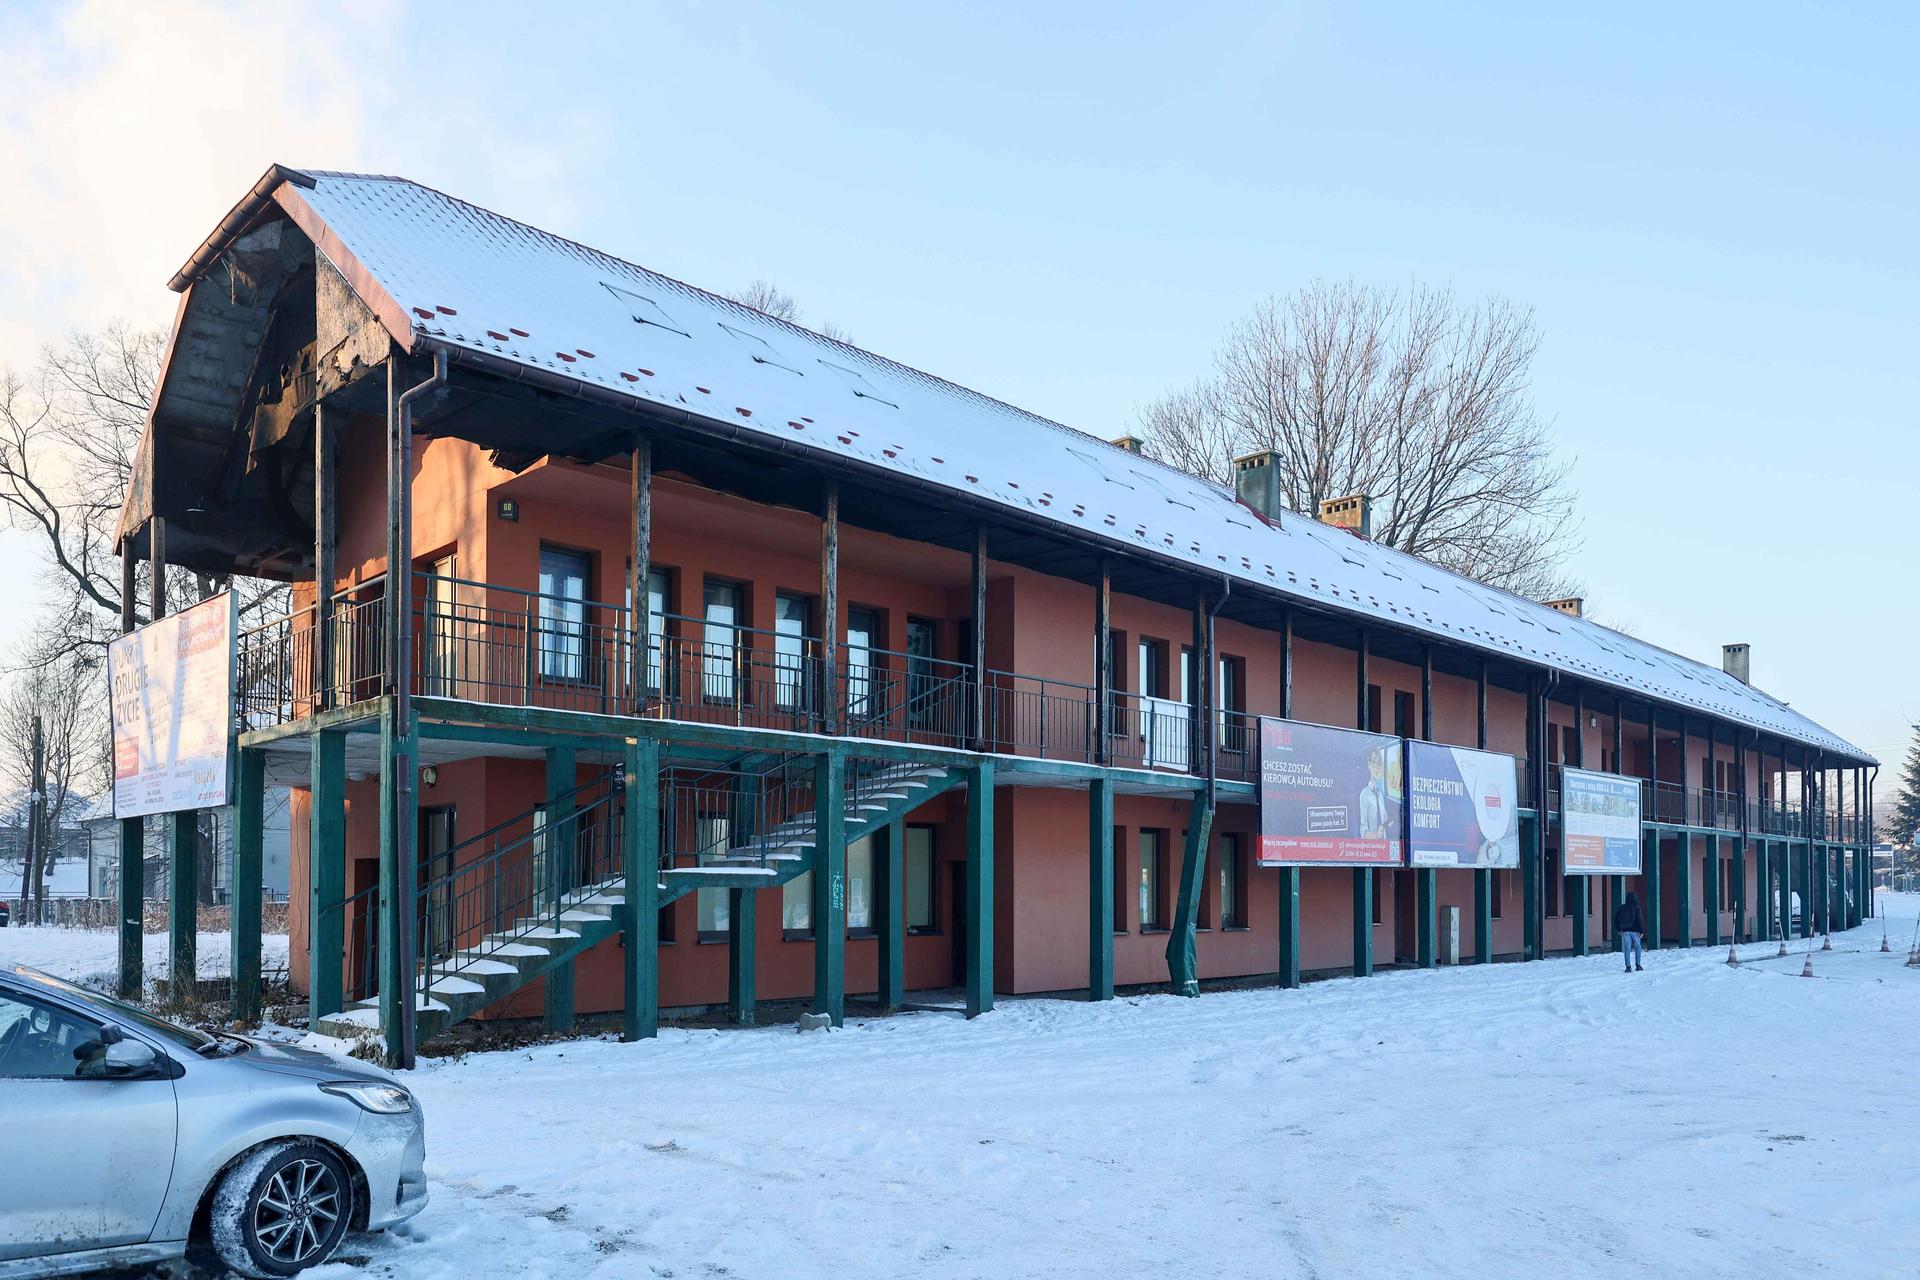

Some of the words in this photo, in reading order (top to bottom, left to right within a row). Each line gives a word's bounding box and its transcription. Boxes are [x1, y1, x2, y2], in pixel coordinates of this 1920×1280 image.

[503, 503, 512, 511] 60
[113, 640, 142, 670] PUNKT
[115, 664, 149, 699] DRUGIE
[116, 697, 140, 727] ŻYCIE
[1263, 760, 1288, 772] CHCESZ
[1288, 762, 1312, 774] ZOSTAĆ
[1263, 772, 1297, 788] KIEROWCĄ
[1297, 776, 1334, 788] AUTOBUSU?
[1412, 777, 1464, 796] BEZPIECZEŃSTWO
[1413, 795, 1441, 810] EKOLOGIA
[1413, 812, 1441, 829] KOMFORT
